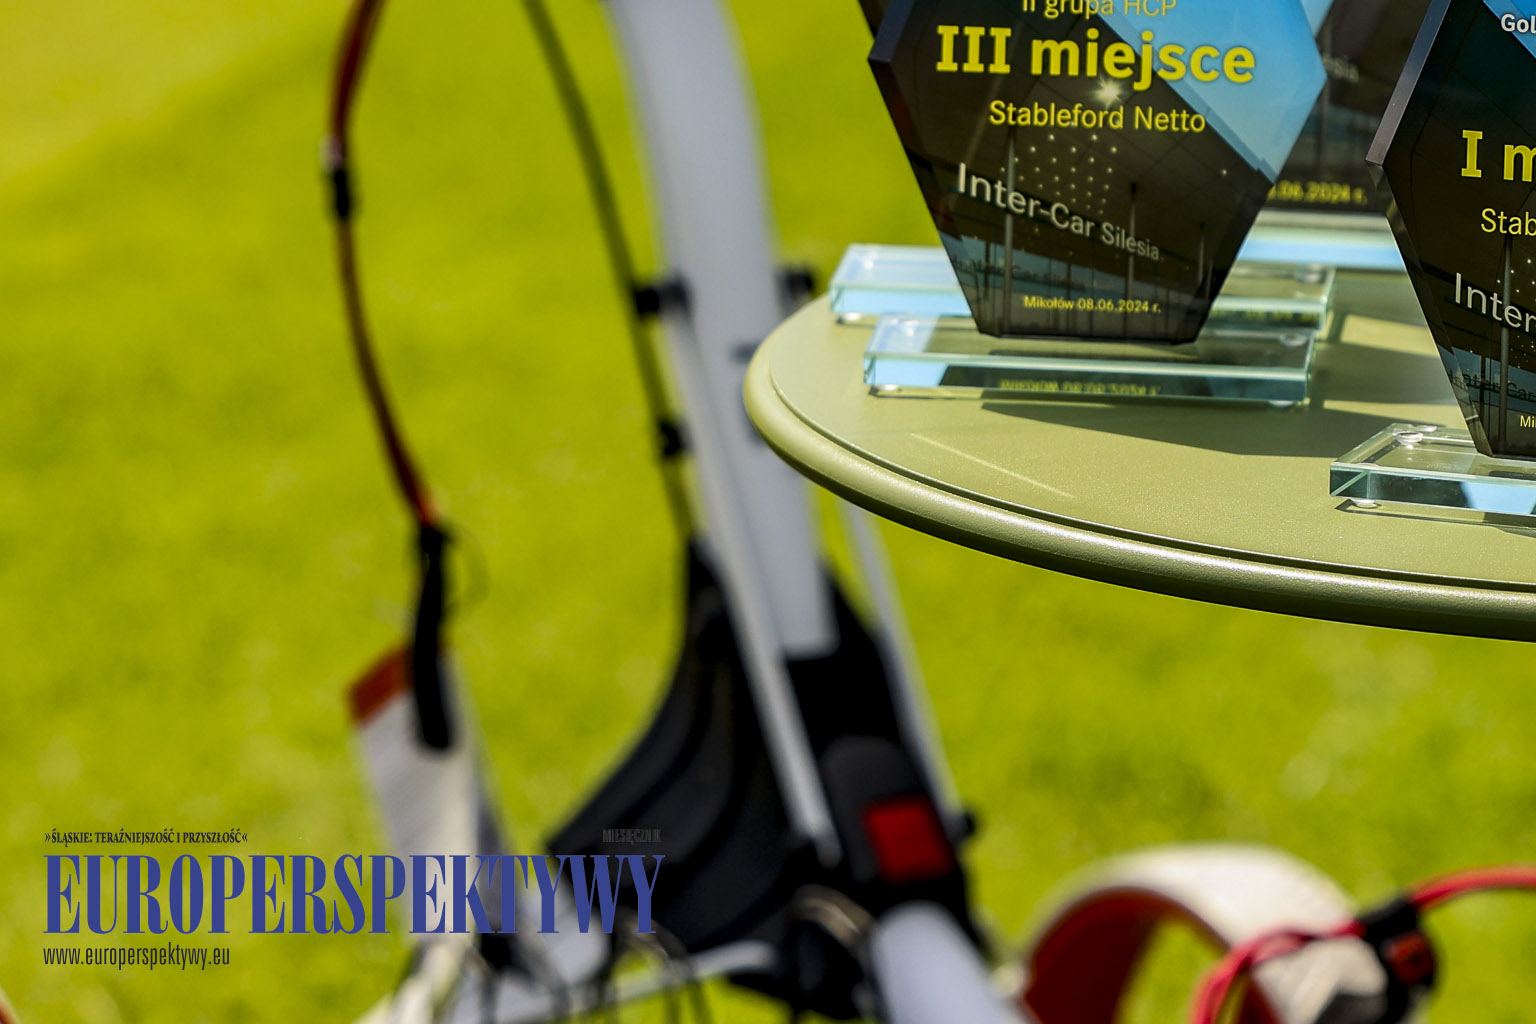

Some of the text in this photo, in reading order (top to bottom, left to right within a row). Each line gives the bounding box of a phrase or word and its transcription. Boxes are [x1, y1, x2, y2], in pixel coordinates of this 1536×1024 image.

[936, 24, 1012, 74] III
[1031, 27, 1256, 91] miejsce
[989, 100, 1206, 133] Stableford Netto
[1461, 129, 1483, 178] I
[958, 162, 1096, 238] Inter-Car
[1023, 296, 1075, 311] Mikołów
[1077, 297, 1149, 313] 08.06.2024
